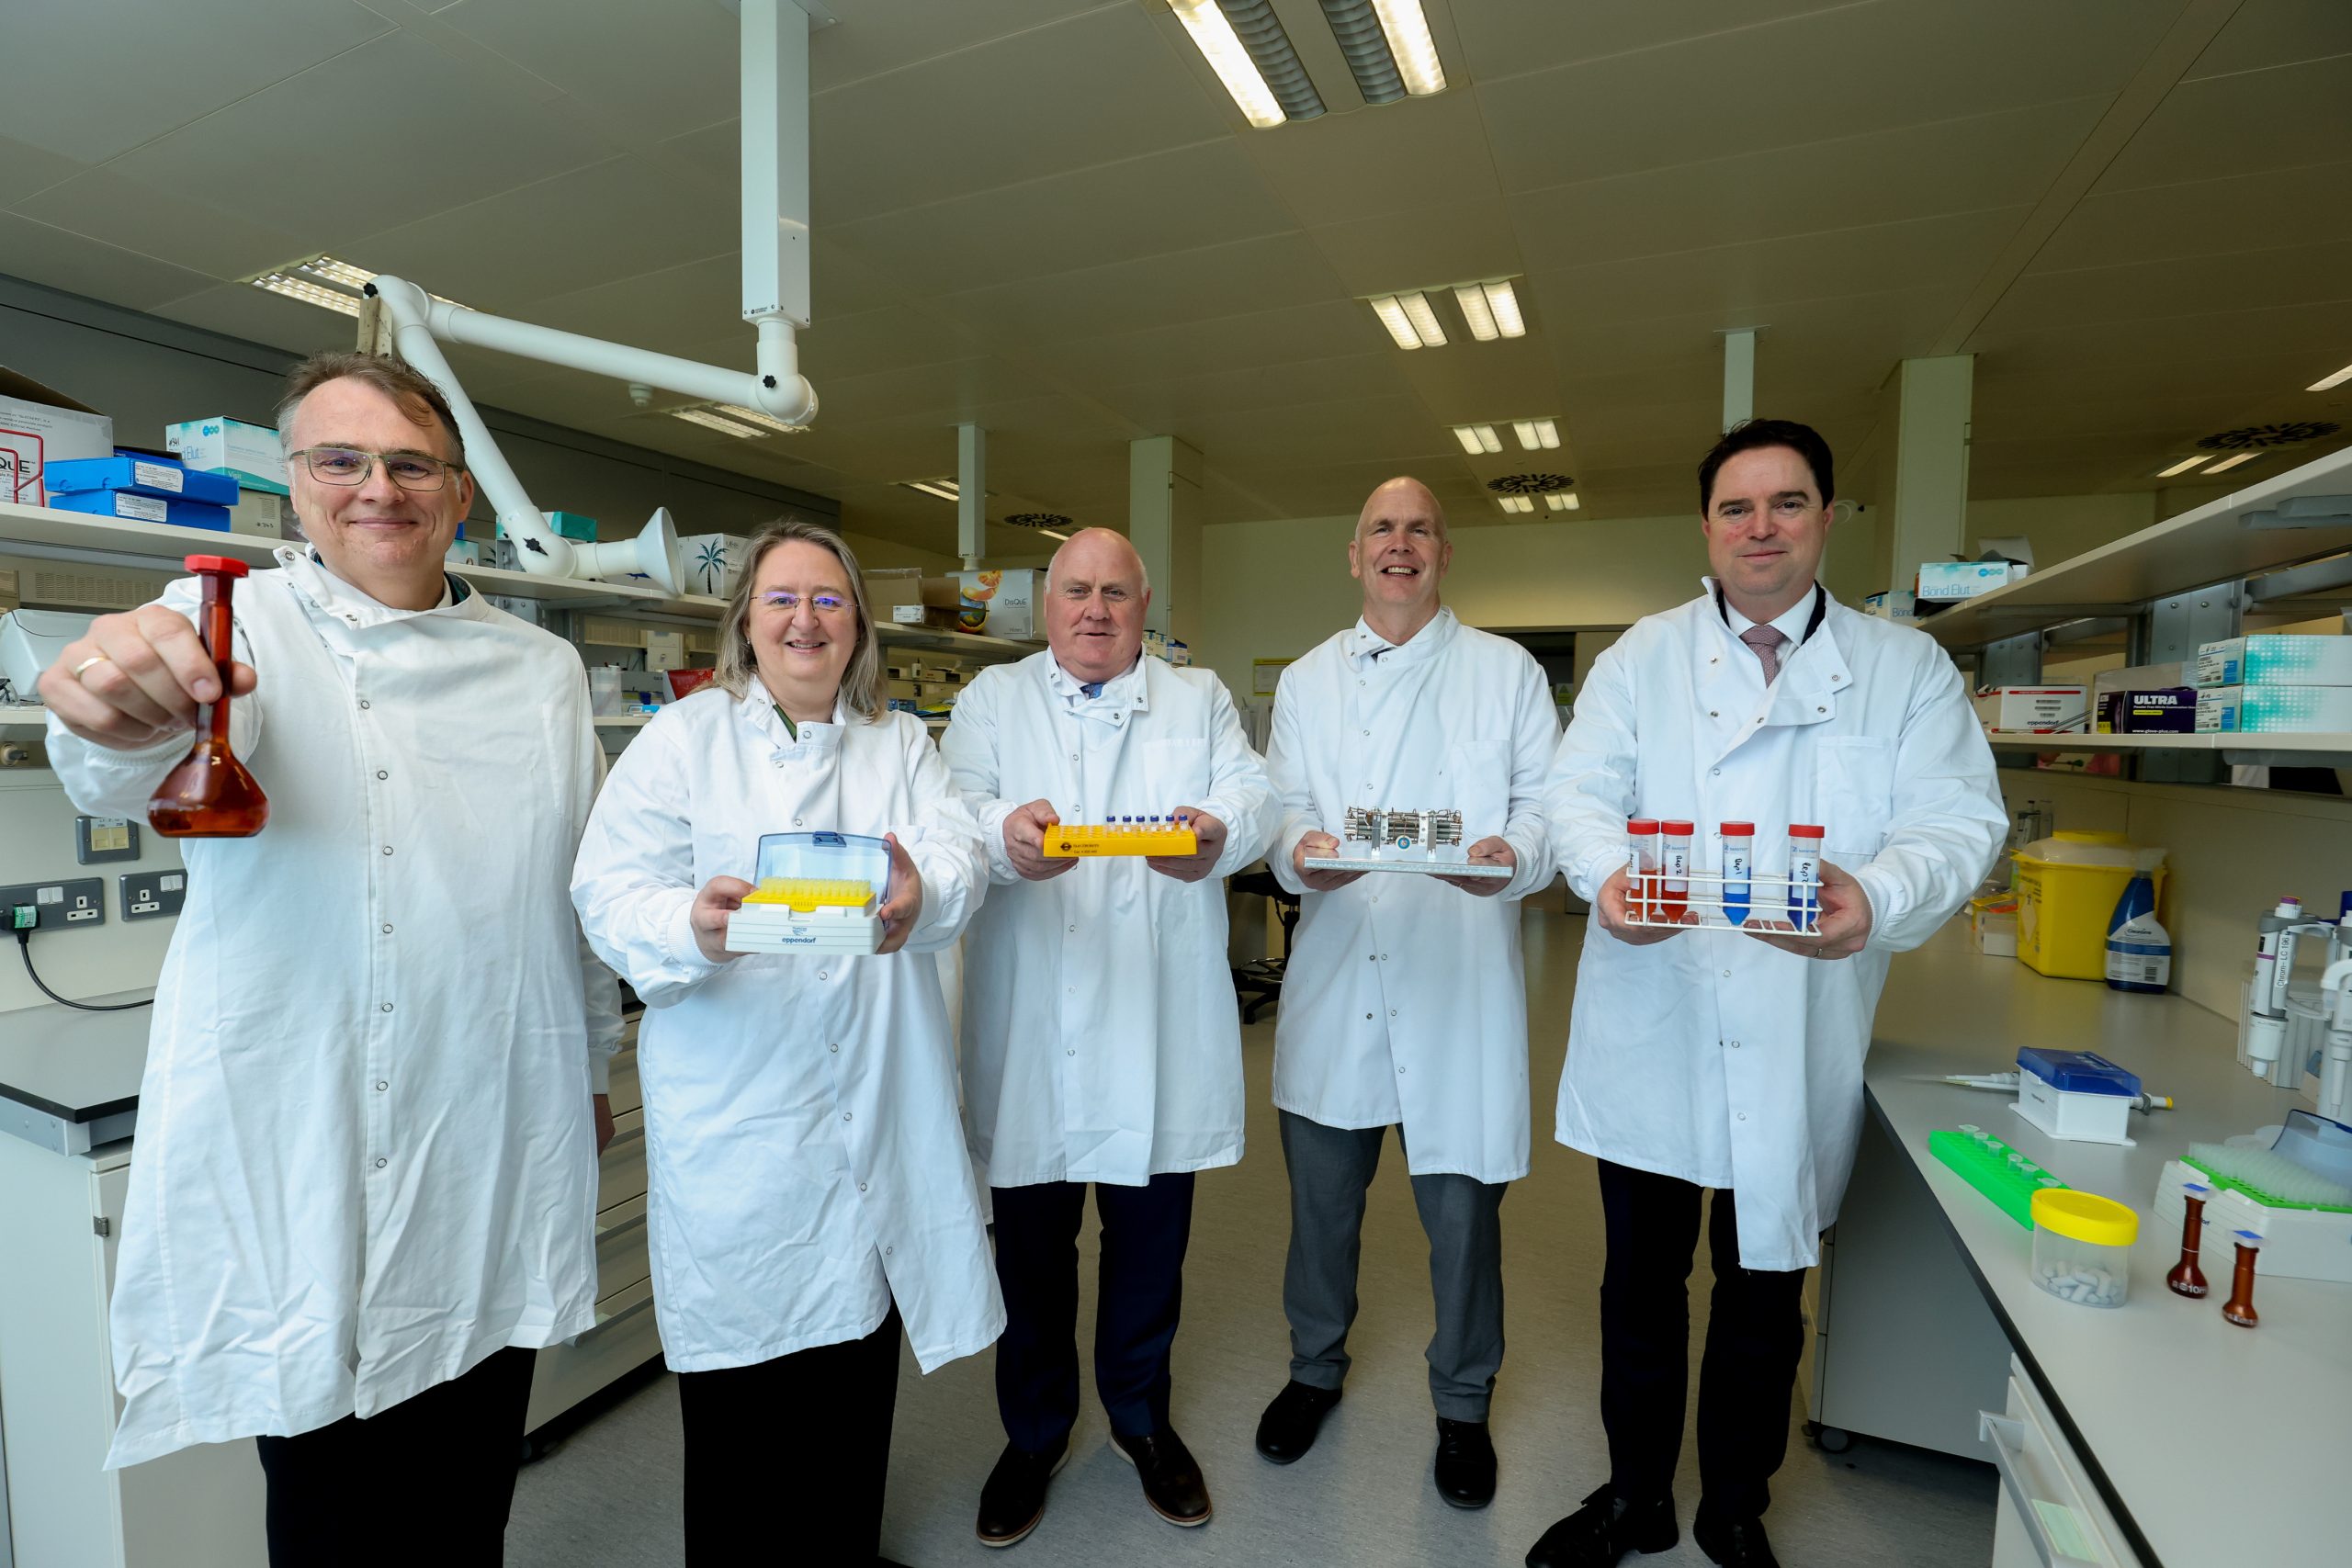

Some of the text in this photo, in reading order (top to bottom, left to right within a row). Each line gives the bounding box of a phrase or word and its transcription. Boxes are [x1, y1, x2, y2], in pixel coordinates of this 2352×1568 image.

[1922, 584, 1970, 596] Bond Elut
[1892, 607, 1914, 617] Bond
[2133, 695, 2177, 705] ULTRA
[2280, 951, 2288, 960] LC
